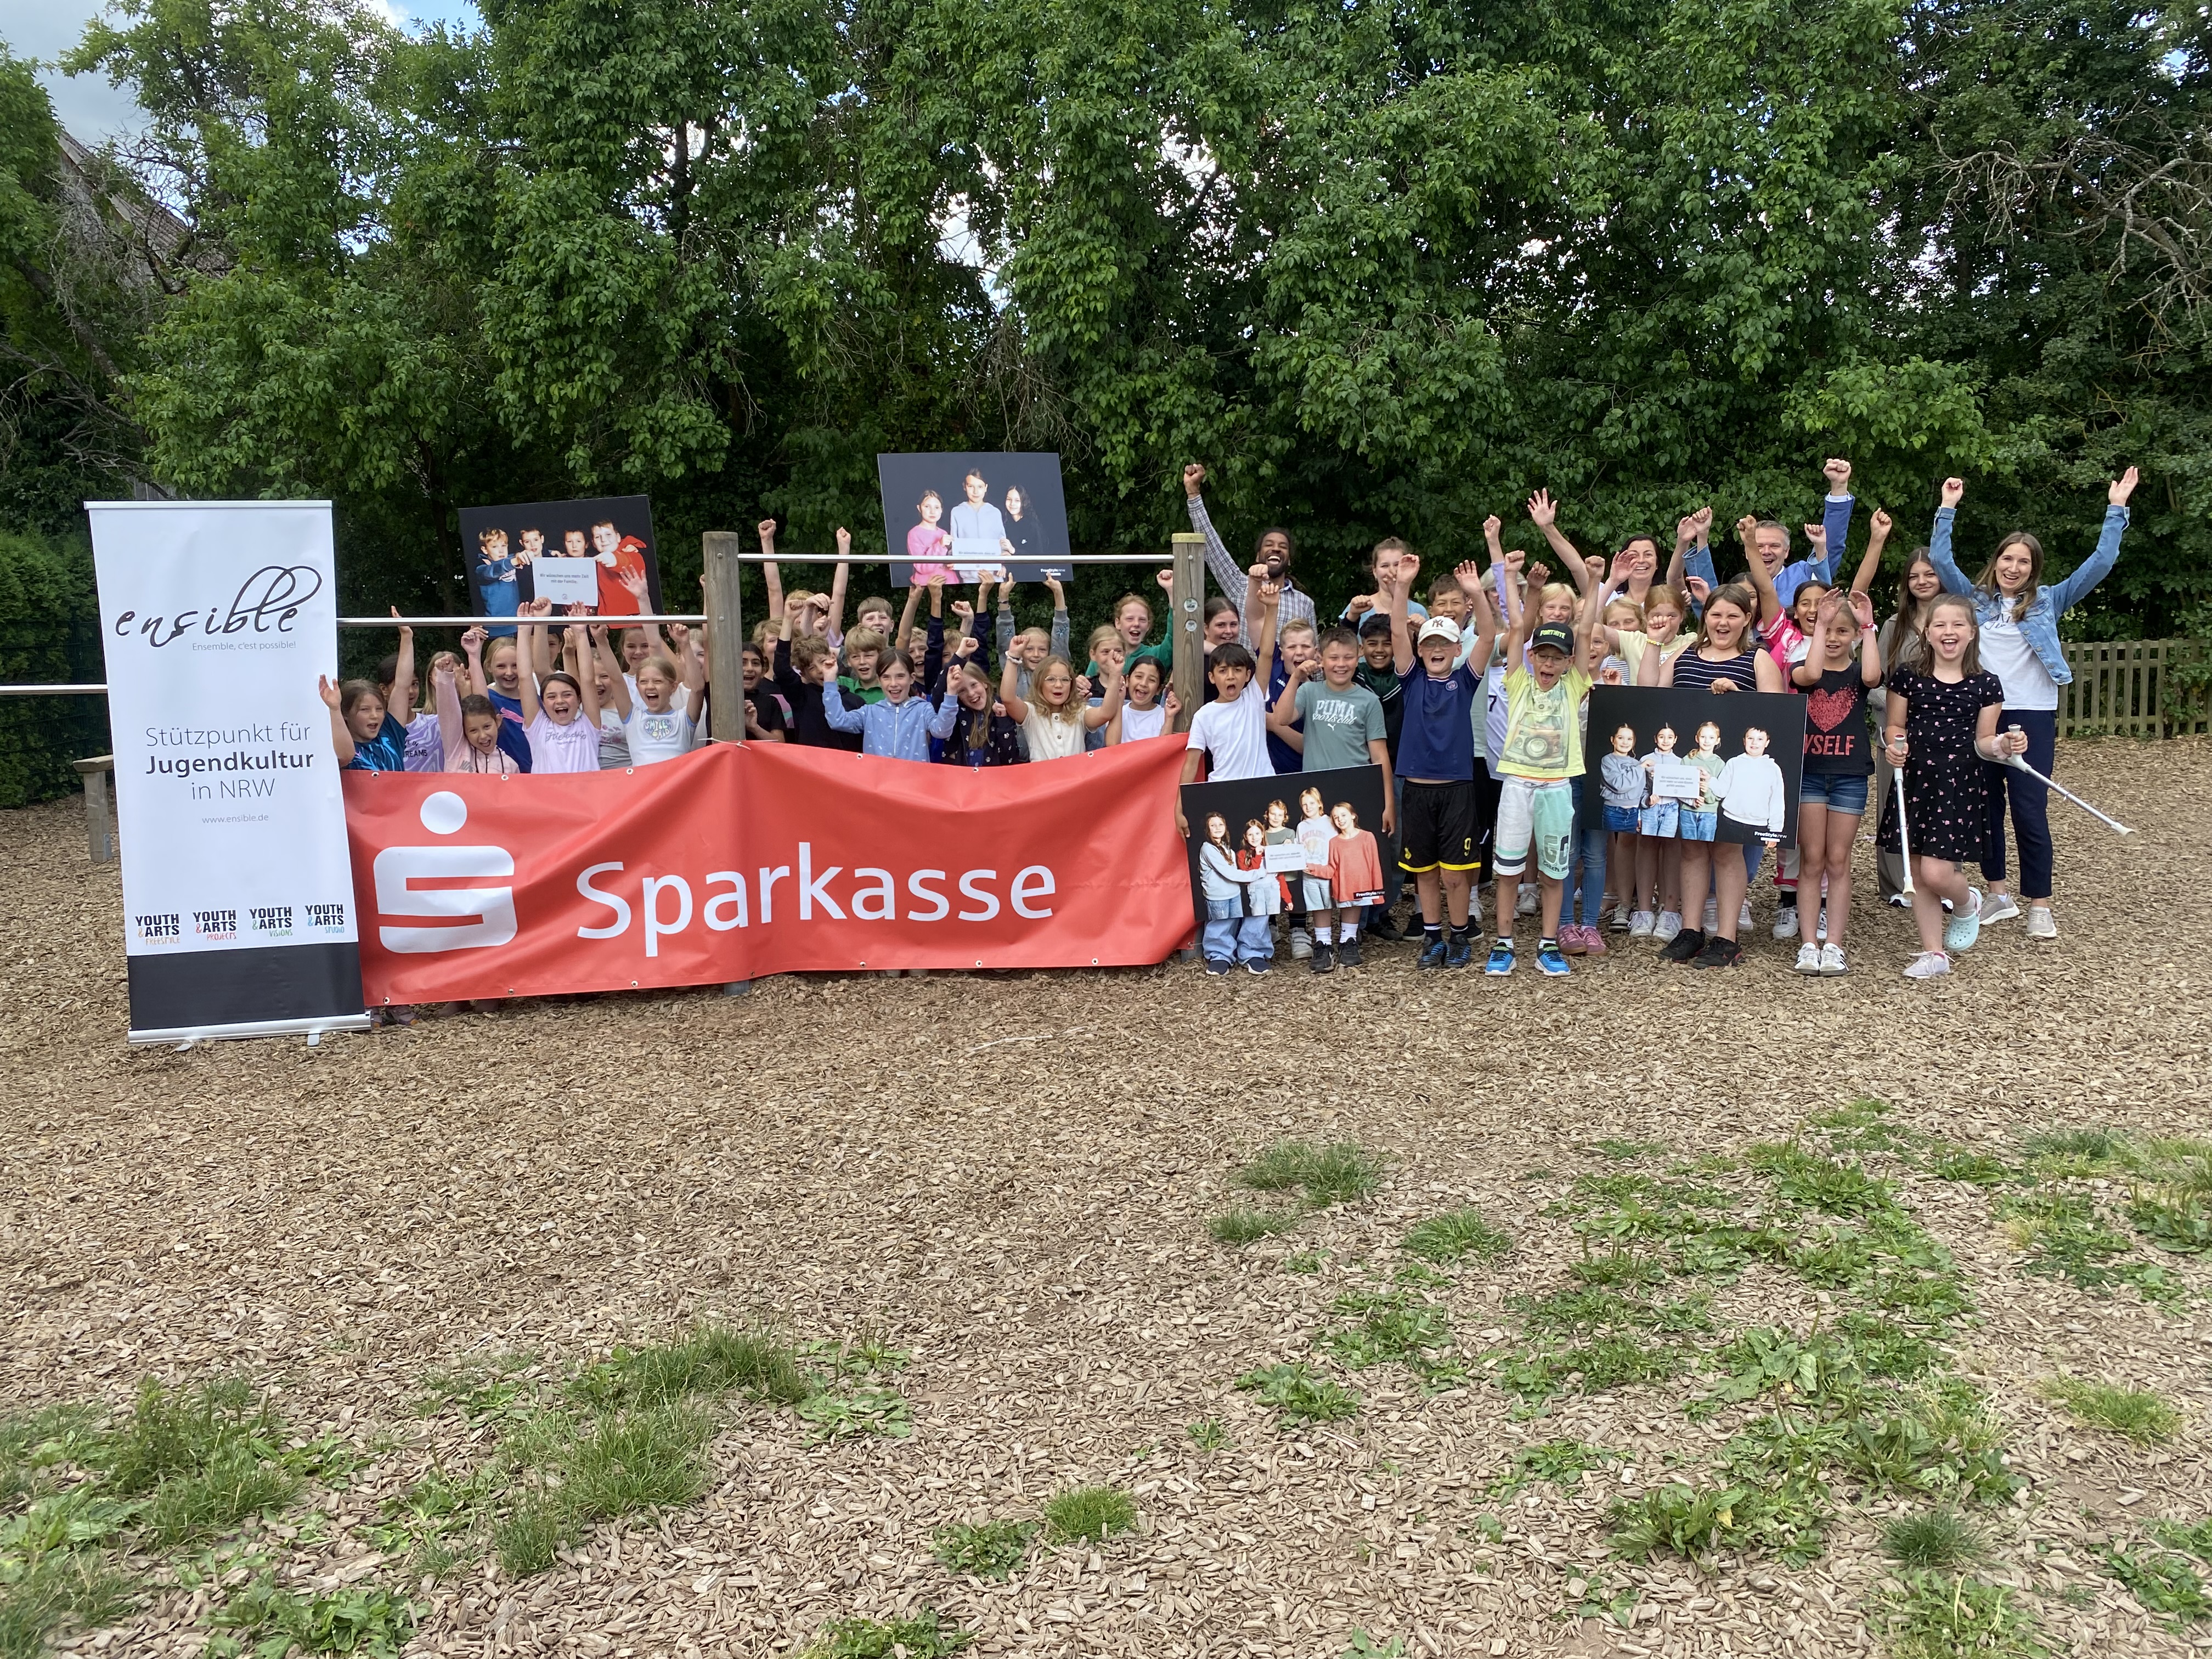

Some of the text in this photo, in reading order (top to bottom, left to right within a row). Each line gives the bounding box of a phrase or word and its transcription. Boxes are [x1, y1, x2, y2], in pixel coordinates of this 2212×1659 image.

[116, 566, 322, 647] ensible
[193, 641, 296, 652] Ensemble, c'est possible!
[1314, 699, 1355, 720] PUMA
[146, 722, 310, 749] Stützpunkt für
[1803, 735, 1855, 755] YSELF
[146, 751, 313, 778] Jugendkultur
[191, 778, 275, 800] in NRW
[201, 813, 270, 825] www.ensible.de
[576, 842, 1055, 958] Sparkasse
[193, 910, 236, 922] YOUTH
[249, 906, 292, 919] YOUTH
[305, 904, 344, 915] YOUTH
[135, 913, 180, 926] YOUTH
[252, 917, 292, 930] &ARTS
[308, 915, 345, 927] &ARTS
[138, 926, 180, 938] &ARTS
[195, 921, 236, 933] &ARTS
[145, 936, 180, 945] FREESTYLE
[206, 932, 237, 941] PROJECTS
